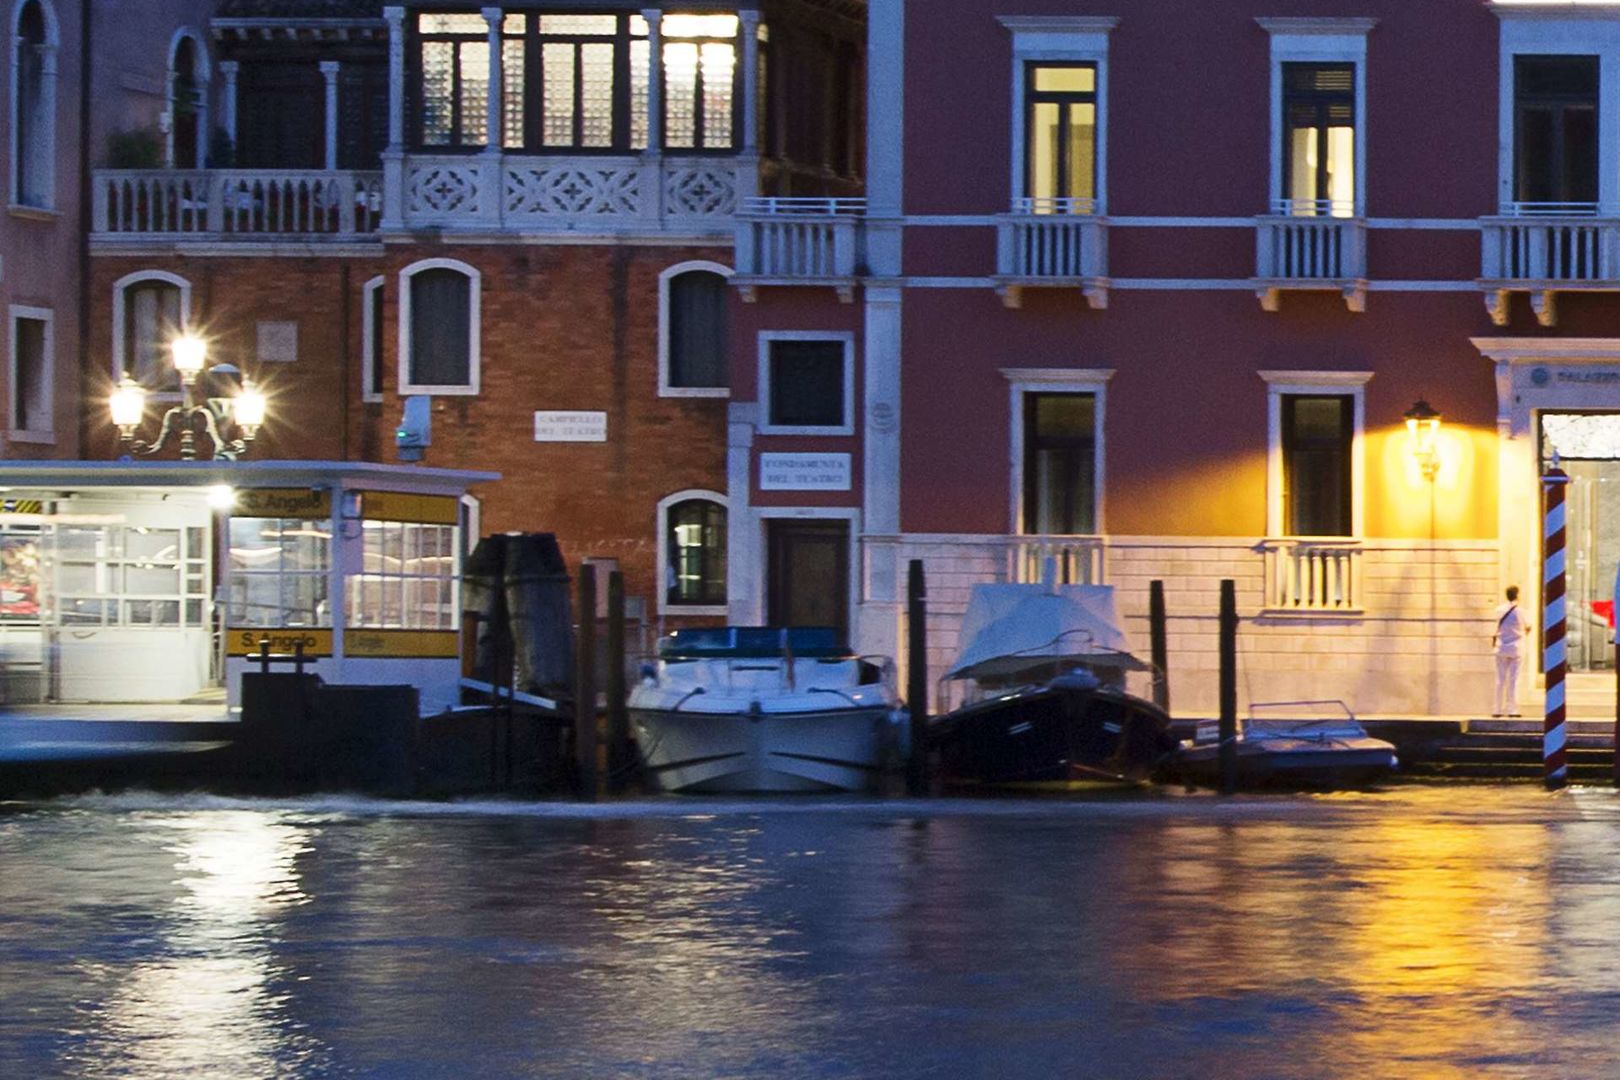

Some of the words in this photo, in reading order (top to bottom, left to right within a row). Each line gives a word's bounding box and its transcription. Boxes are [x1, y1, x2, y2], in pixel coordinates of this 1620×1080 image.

[1558, 371, 1620, 383] PALAZZO
[765, 459, 845, 468] FONDAMENTA
[241, 632, 257, 647] S.
